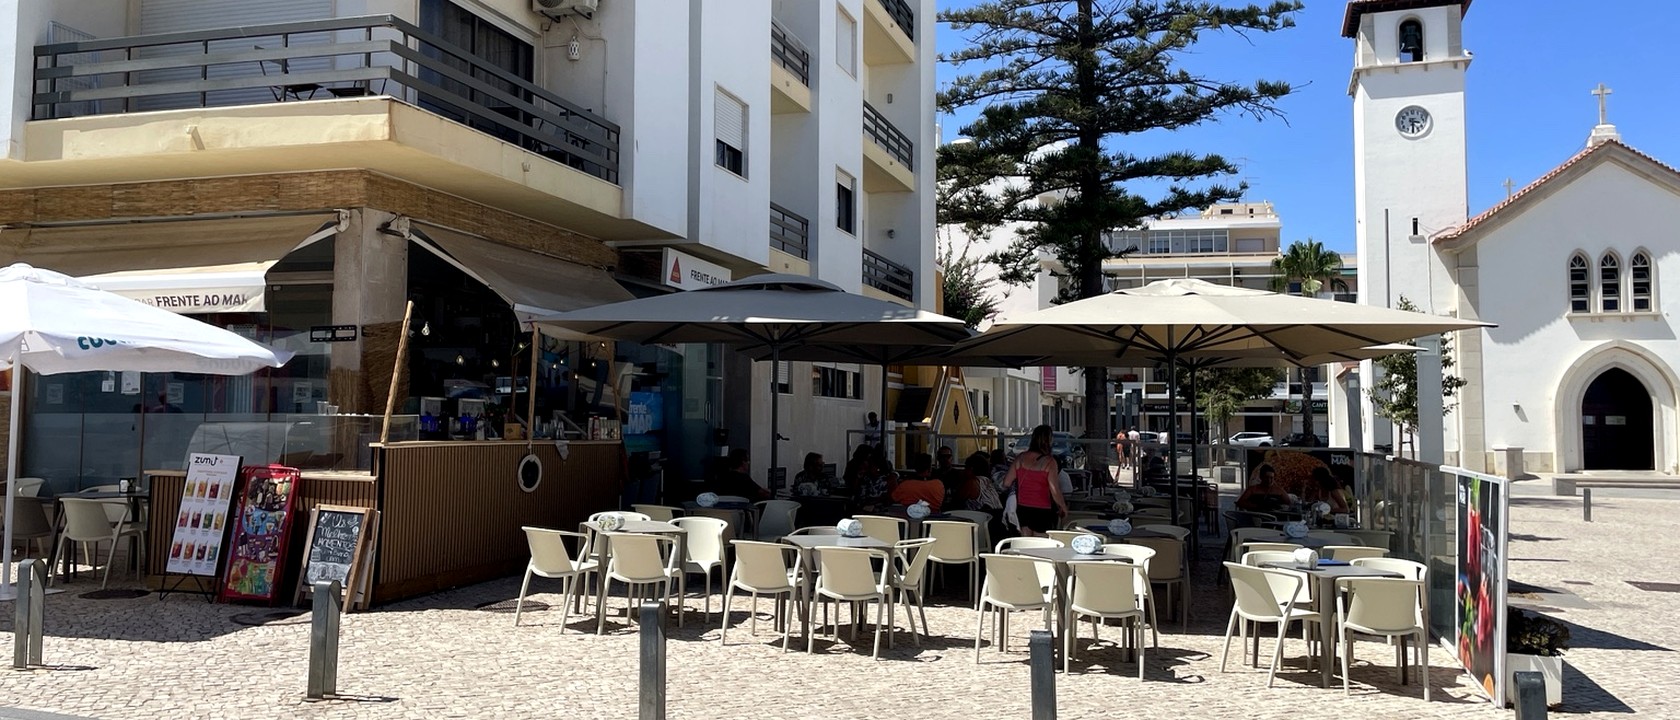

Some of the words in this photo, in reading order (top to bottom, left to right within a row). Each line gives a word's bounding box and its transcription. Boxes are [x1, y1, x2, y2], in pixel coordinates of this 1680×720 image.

[690, 269, 710, 285] FRENTE
[155, 295, 200, 307] FRENTE
[628, 414, 652, 434] MAR
